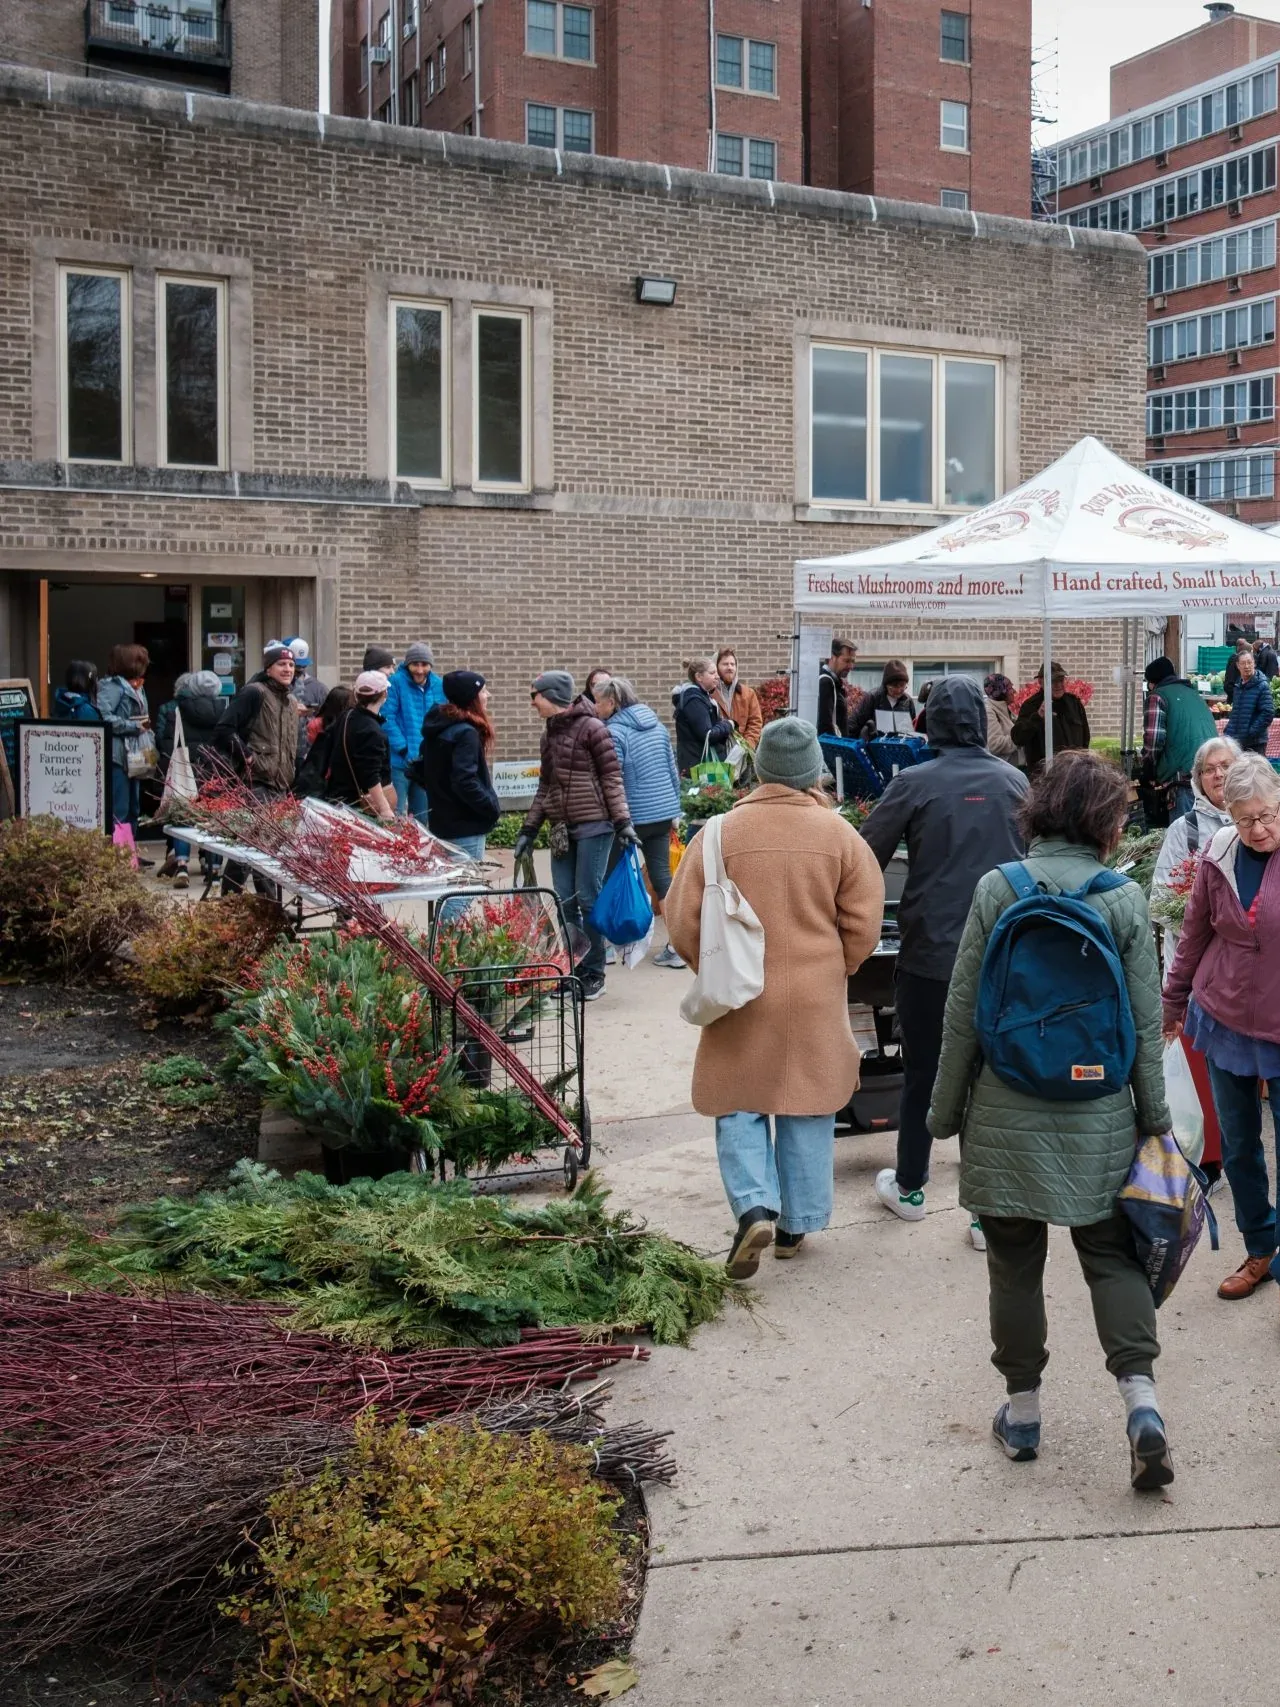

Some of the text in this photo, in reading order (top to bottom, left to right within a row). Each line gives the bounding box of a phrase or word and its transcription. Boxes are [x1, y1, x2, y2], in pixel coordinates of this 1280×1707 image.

[1080, 493, 1114, 517] RIVER
[1103, 483, 1155, 500] VALLEY
[807, 573, 855, 595] Freshest
[857, 574, 933, 596] Mushrooms
[937, 574, 964, 596] and
[1052, 572, 1101, 591] Hand
[1106, 571, 1168, 592] crafted,
[1172, 570, 1217, 590] Small
[1219, 569, 1267, 590] batch,
[869, 598, 947, 613] www.rvrvalley.com
[44, 740, 80, 752] Indoor
[39, 753, 84, 765] Farmers'
[44, 766, 82, 777] Market
[495, 771, 518, 781] Alley
[47, 800, 80, 813] Today
